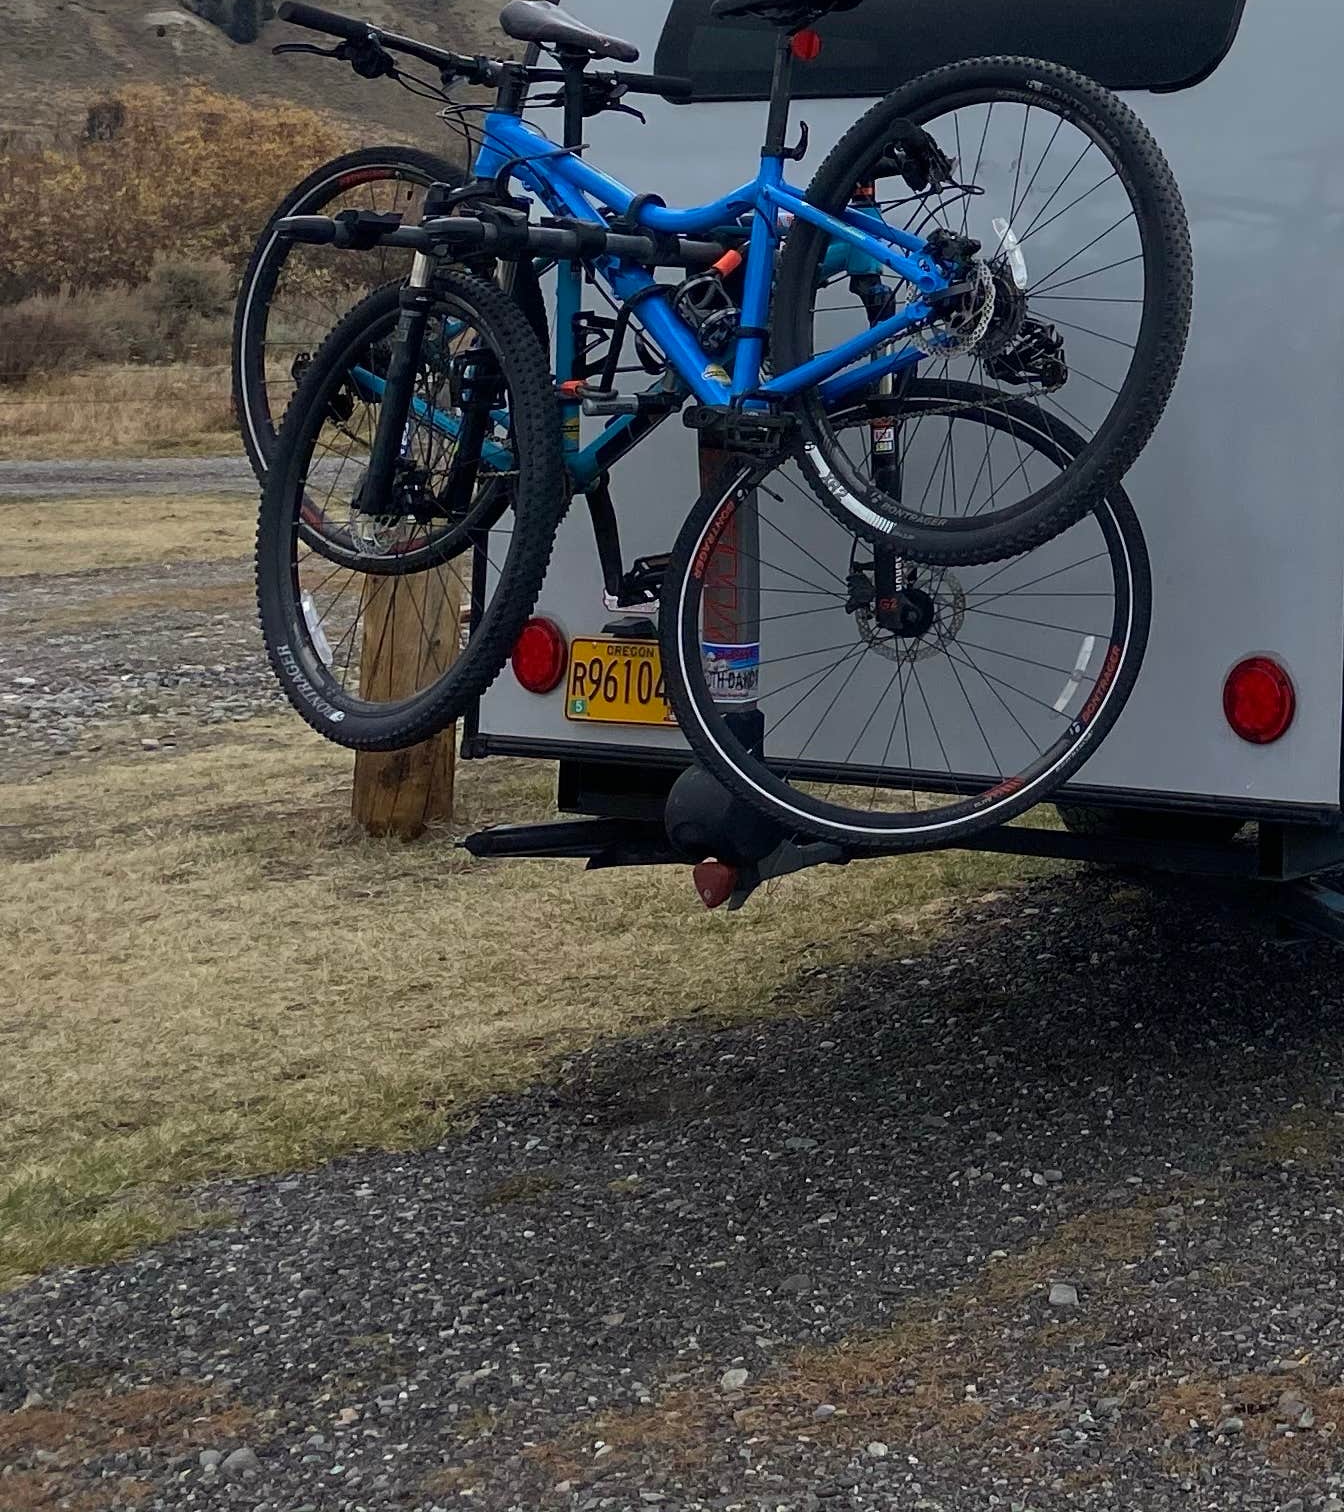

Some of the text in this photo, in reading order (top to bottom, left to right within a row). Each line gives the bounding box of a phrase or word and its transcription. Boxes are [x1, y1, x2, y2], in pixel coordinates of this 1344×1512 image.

[880, 501, 949, 527] BONTRAGER
[606, 644, 655, 658] OREGON
[277, 644, 337, 718] BONTRAGER
[575, 700, 583, 713] 5
